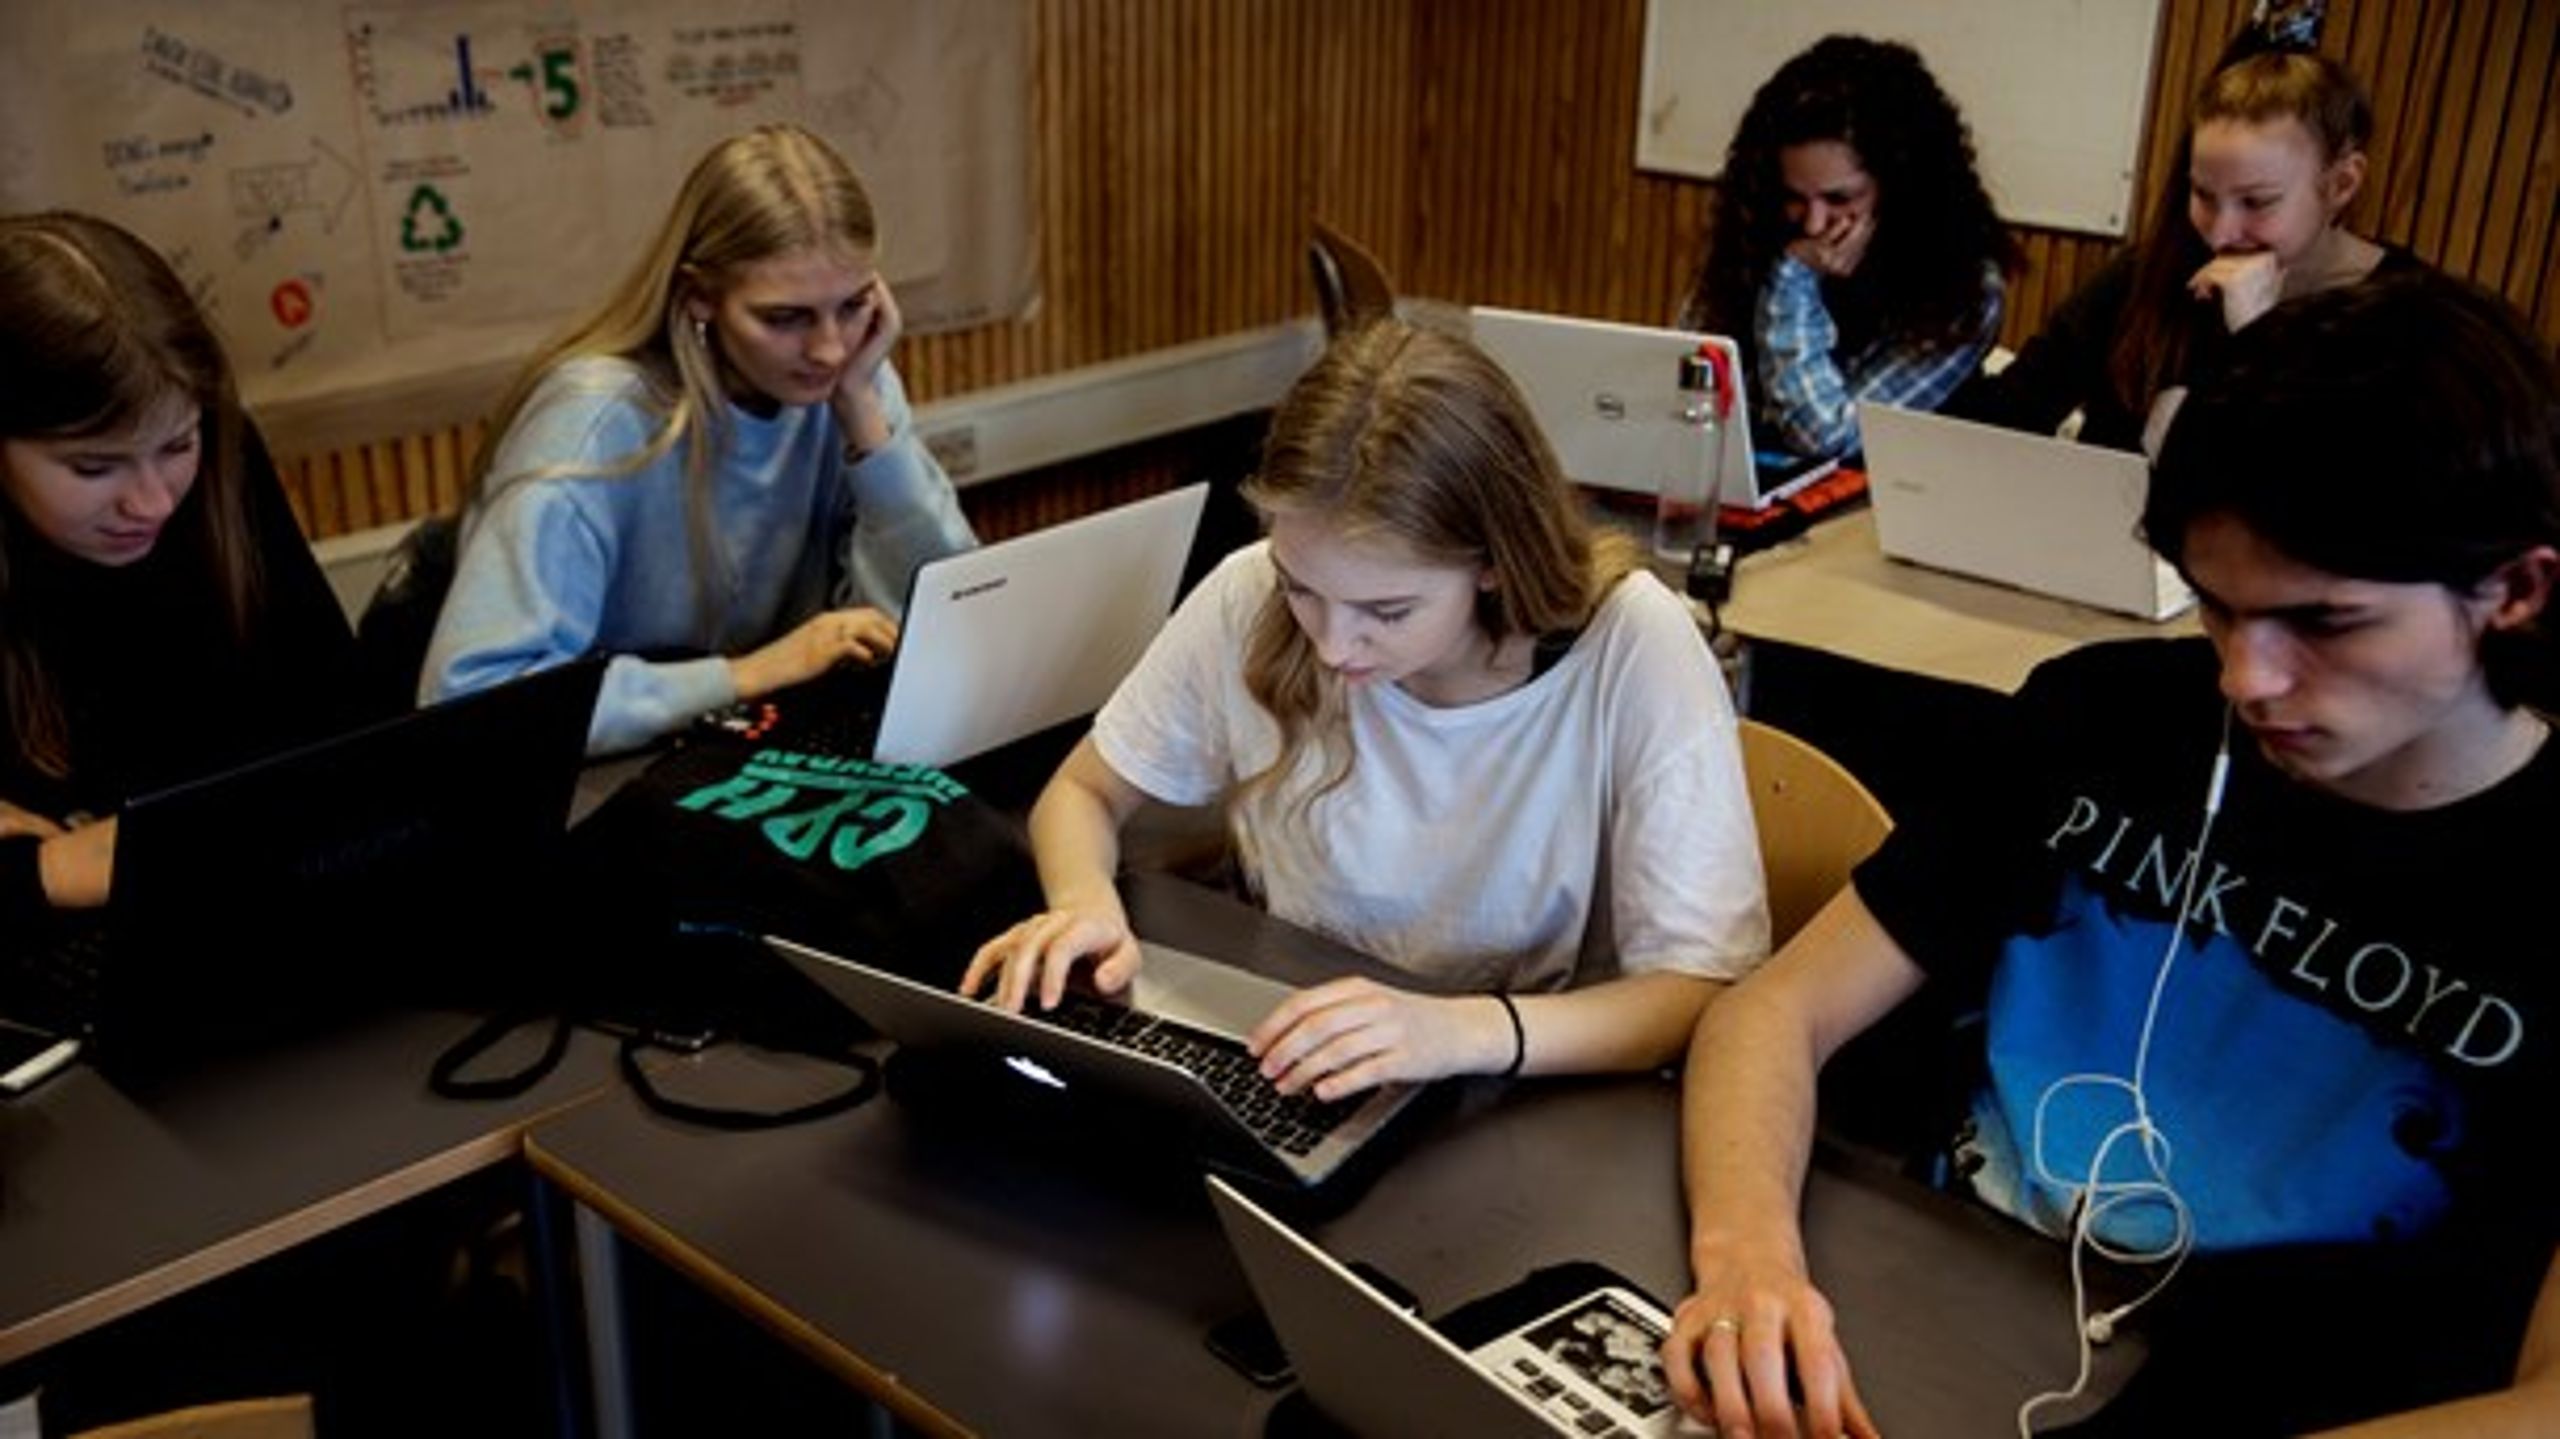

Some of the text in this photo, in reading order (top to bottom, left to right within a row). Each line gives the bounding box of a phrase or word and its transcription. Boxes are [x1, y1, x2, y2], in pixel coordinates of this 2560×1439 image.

[674, 775, 932, 869] CPH
[2047, 796, 2525, 1066] PINK FLOYD
